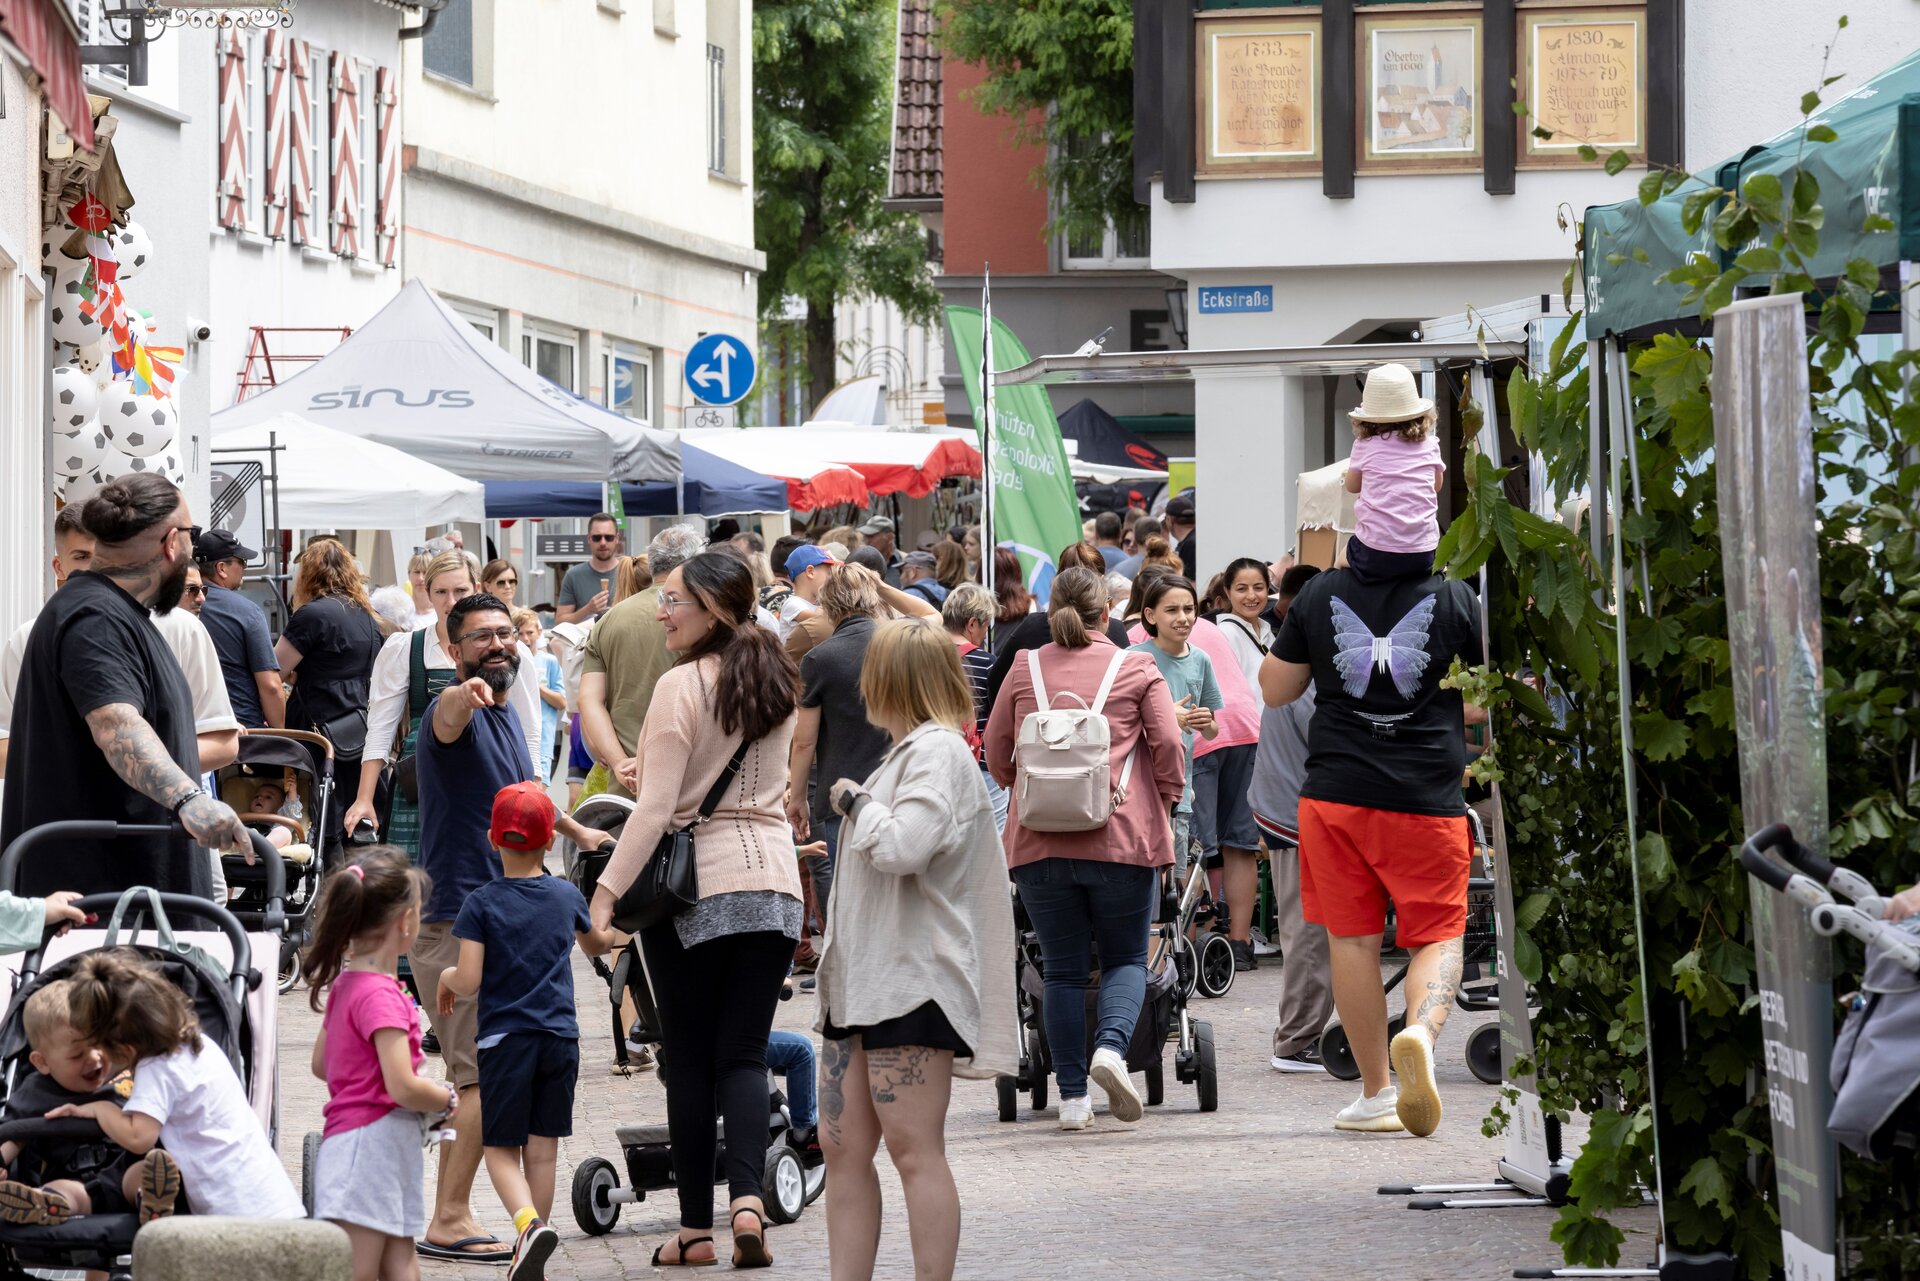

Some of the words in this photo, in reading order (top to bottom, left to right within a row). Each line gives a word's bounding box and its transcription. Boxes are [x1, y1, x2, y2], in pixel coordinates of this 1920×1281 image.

[1567, 30, 1604, 46] 1830
[1384, 48, 1425, 62] Obertor
[1202, 291, 1269, 309] Eckstraße
[307, 385, 475, 411] sinus
